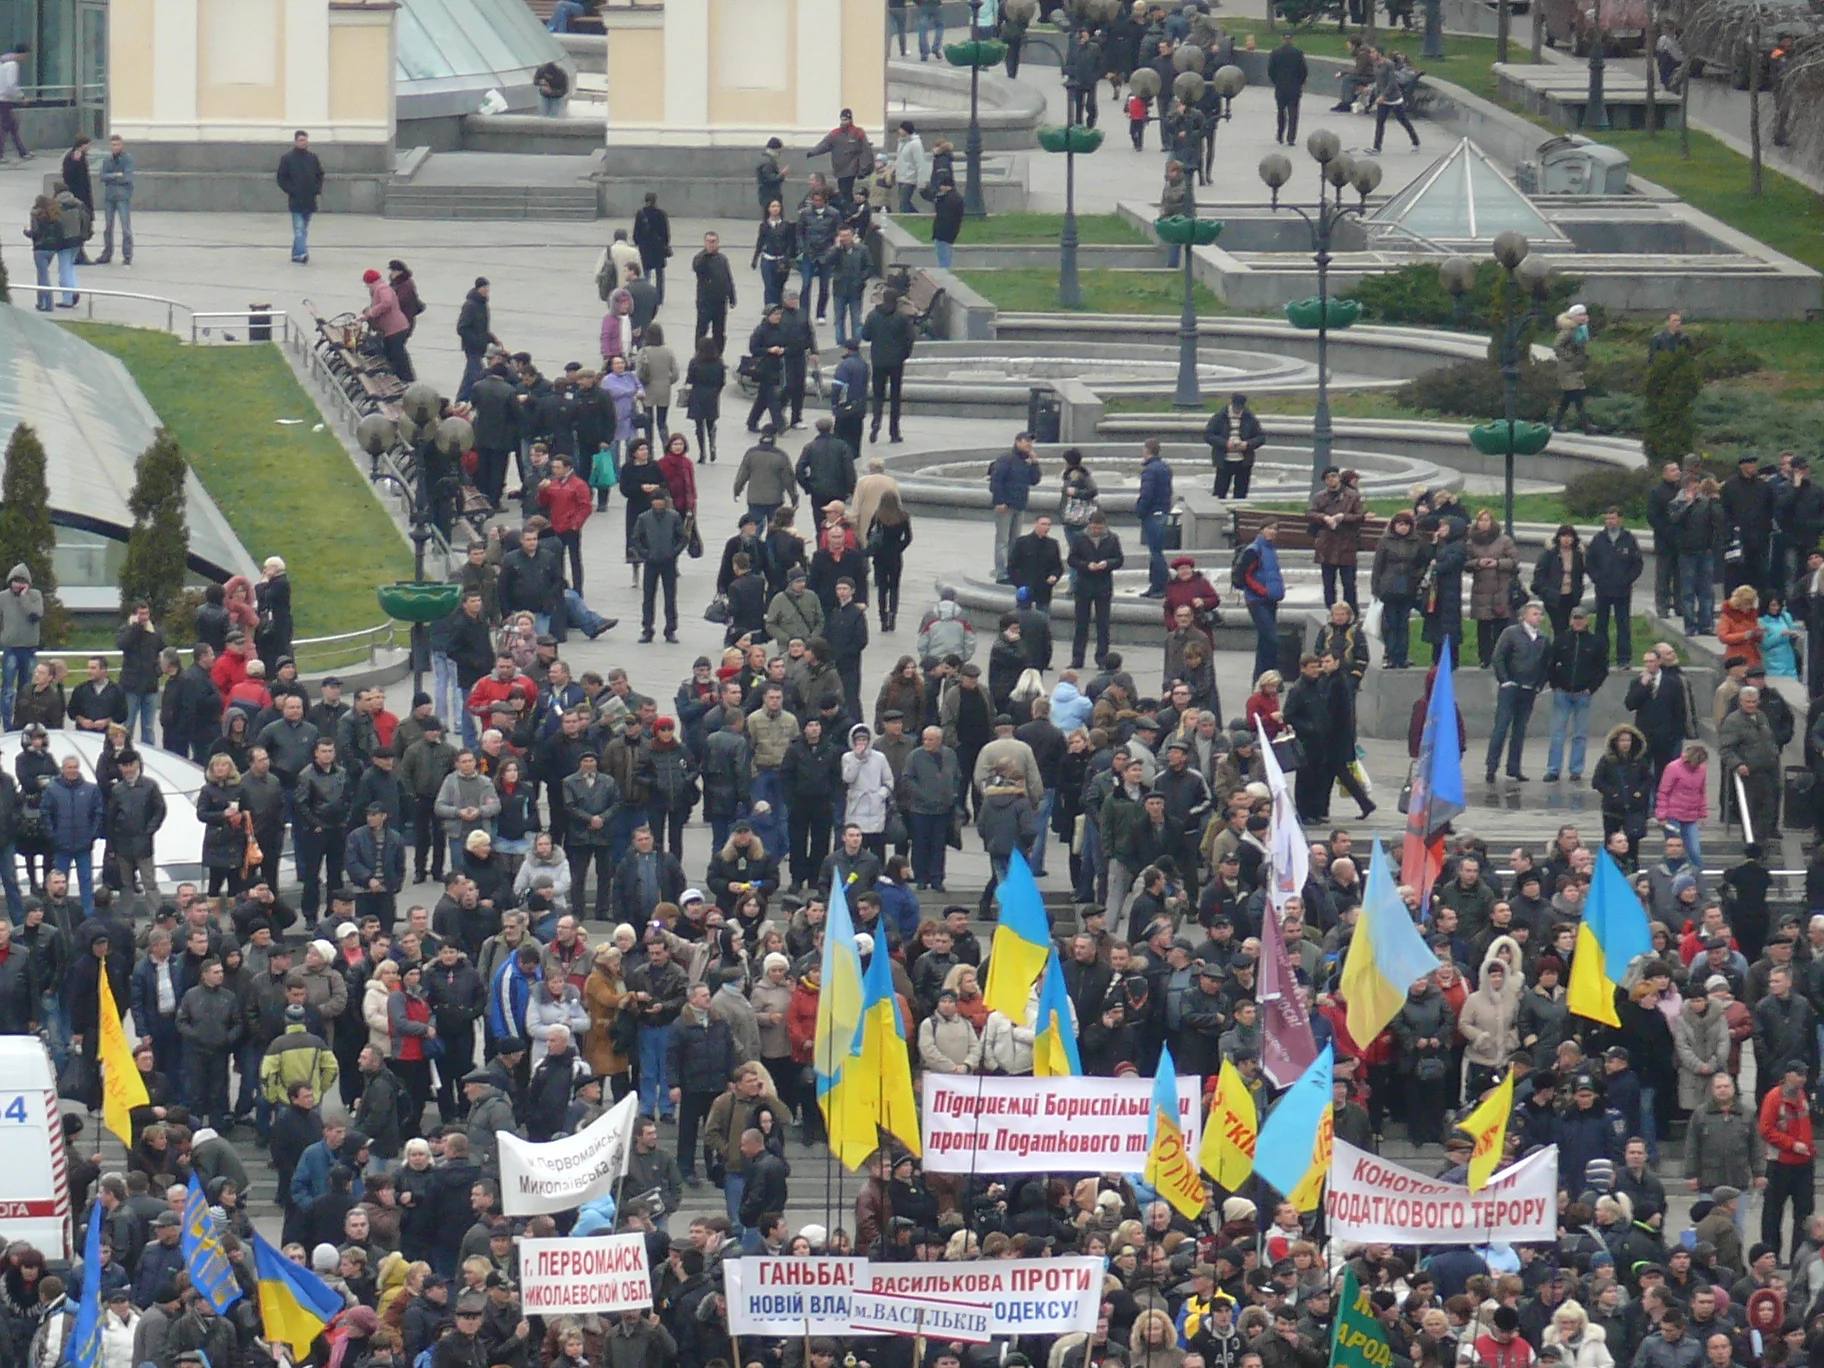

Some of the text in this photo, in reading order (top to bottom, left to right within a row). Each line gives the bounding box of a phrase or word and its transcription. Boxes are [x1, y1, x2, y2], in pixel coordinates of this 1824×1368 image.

[932, 1090, 1039, 1119] Підприємці
[929, 1130, 990, 1155] проти
[994, 1129, 1119, 1157] Податкового
[1324, 1190, 1547, 1229] ПОДАТКОВОГО ТЕРОРУ
[538, 1246, 643, 1276] ПЕРВОМАЙСК
[758, 1260, 855, 1287] ГАНЬБА!
[525, 1277, 653, 1307] ИКОЛАЕВСКОЙ ОБЛ.
[871, 1268, 1091, 1294] ВАСИЛЬКОВА ПРОТИ
[749, 1291, 804, 1315] НОВІЙ
[990, 1300, 1080, 1323] ОДЕКСУ!
